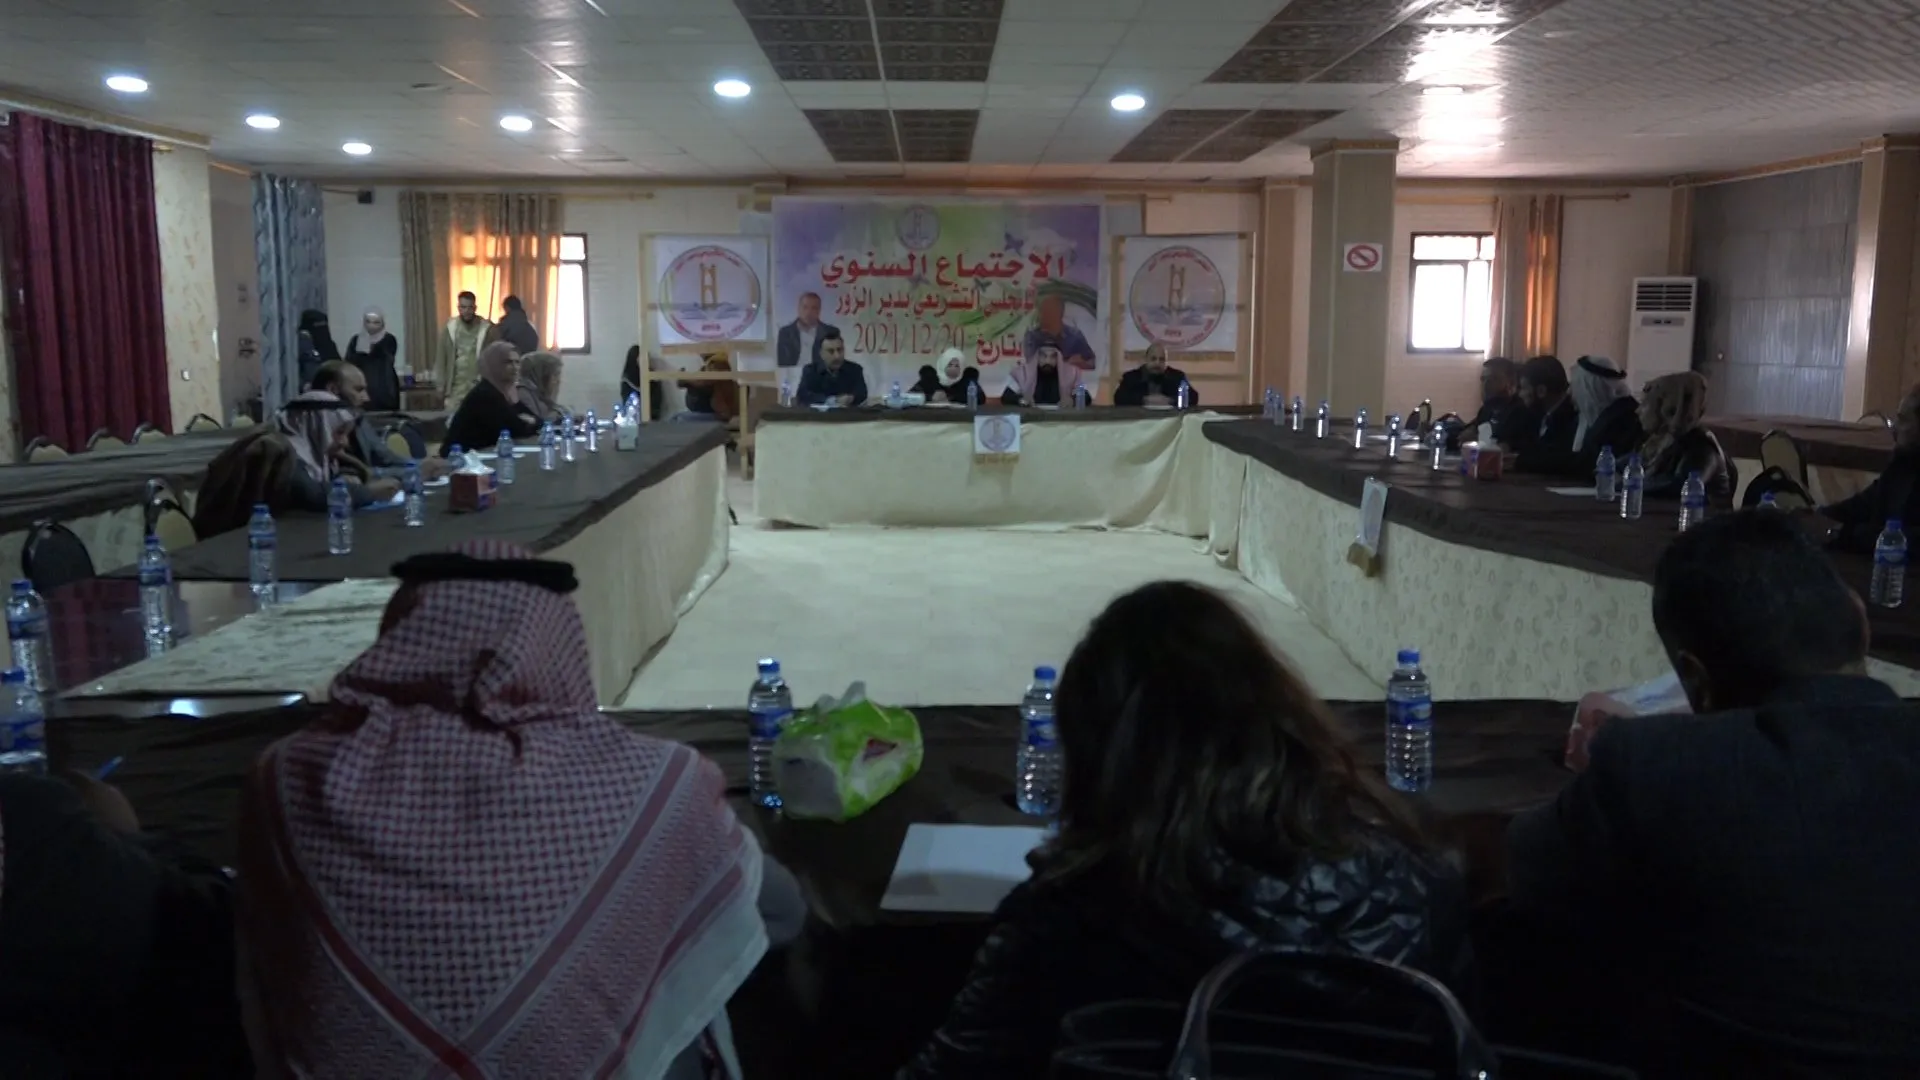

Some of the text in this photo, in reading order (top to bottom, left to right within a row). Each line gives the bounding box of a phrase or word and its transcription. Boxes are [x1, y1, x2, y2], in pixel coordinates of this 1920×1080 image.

[820, 251, 1065, 288] الاجتماع السنوي
[835, 286, 872, 316] الزور
[876, 289, 910, 318] بدير
[913, 287, 981, 319] التشريعي
[975, 334, 1022, 366] بتاريخ
